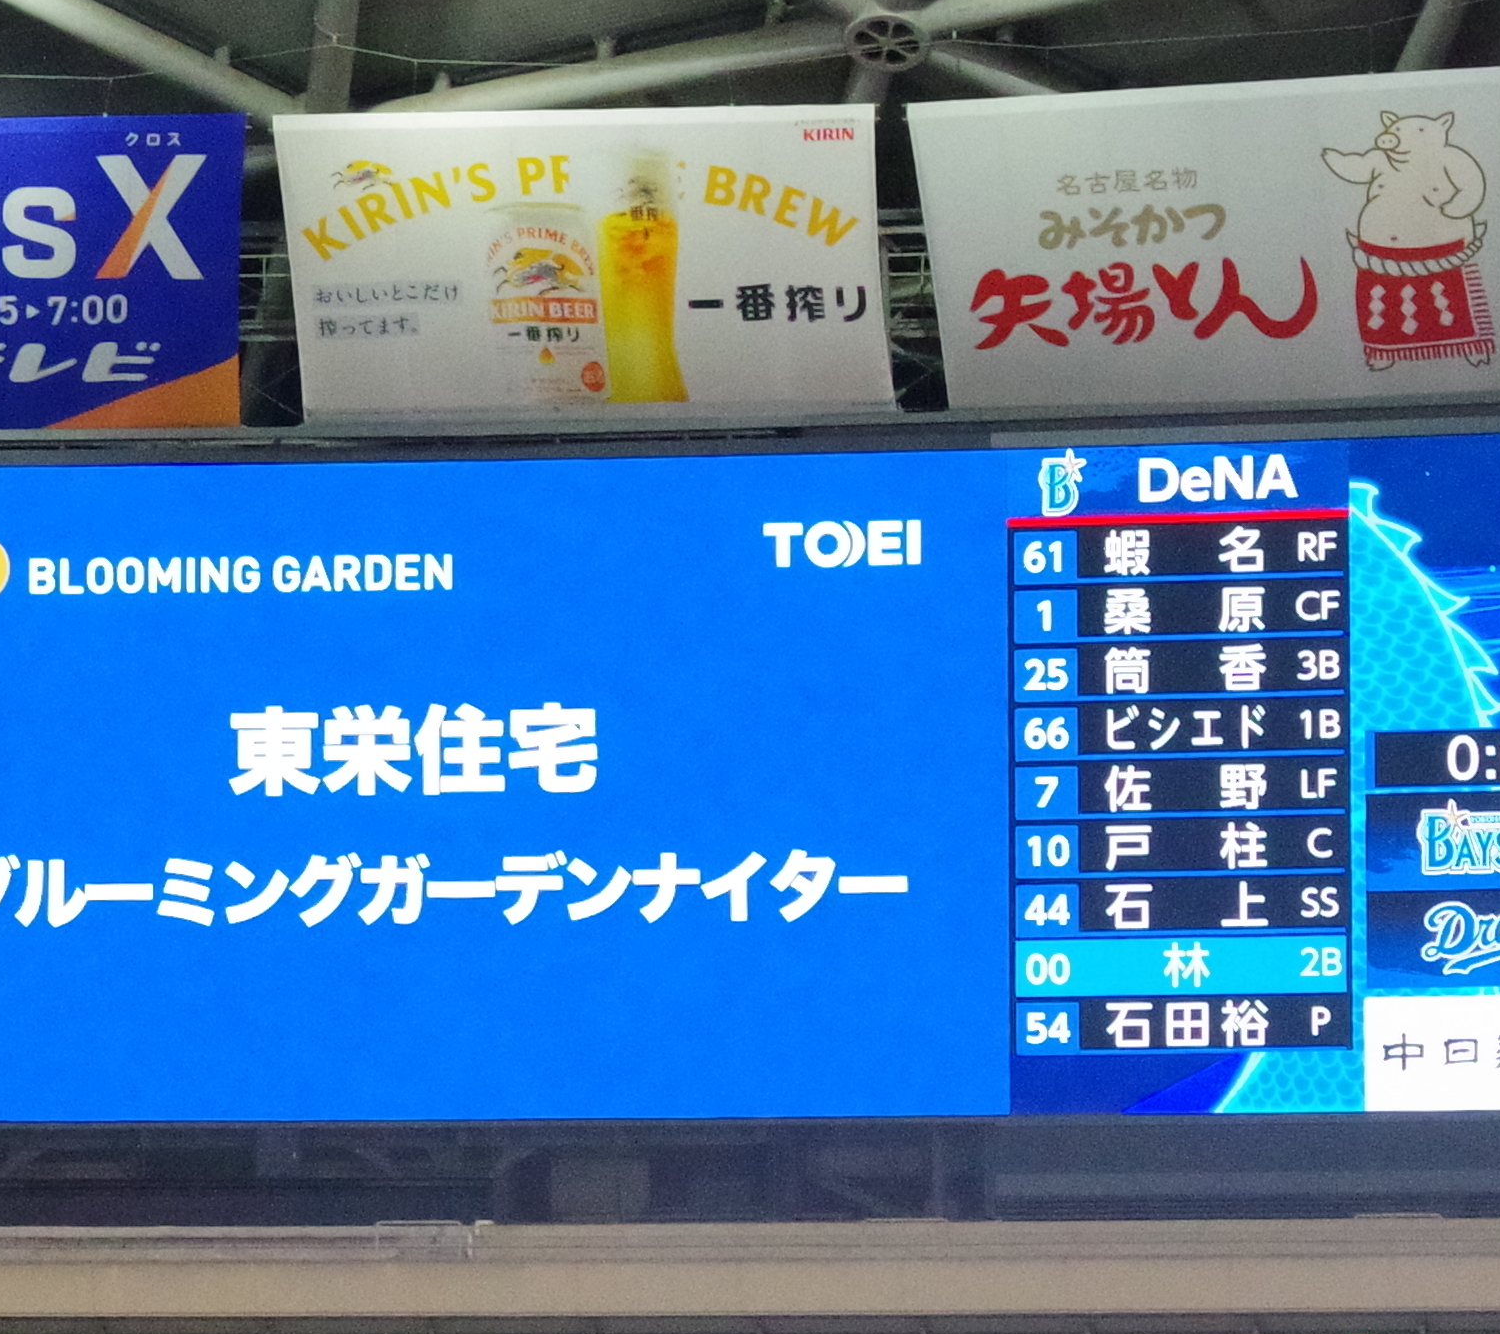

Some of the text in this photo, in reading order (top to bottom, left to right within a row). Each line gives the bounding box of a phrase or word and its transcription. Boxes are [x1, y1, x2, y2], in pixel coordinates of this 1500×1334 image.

[123, 130, 184, 148] クロス
[802, 127, 855, 142] KIRIN
[1056, 167, 1199, 197] 名古屋名物
[300, 161, 498, 262] KIRIN'S
[702, 164, 860, 248] BREW
[1037, 202, 1226, 251] みそかつ
[46, 293, 130, 326] 7:00
[314, 283, 460, 305] おいしいとこだけ
[494, 300, 596, 318] KIRIN BEER
[687, 284, 868, 323] 一番搾り
[969, 256, 1318, 350] 矢場とん
[1137, 453, 1300, 504] DeNA
[28, 552, 454, 596] BLOOMING GARDEN
[1022, 540, 1063, 575] 61
[1296, 529, 1339, 563] RF
[1036, 585, 1342, 636] 1 桑原 CF
[1023, 643, 1341, 695] 25 筒香 3B
[227, 701, 599, 798] 東栄住宅
[1023, 703, 1342, 751] 66 ビシエド 1B
[1034, 762, 1338, 814] 7 佐野 LF
[1026, 820, 1334, 872] 10 戸柱 C
[1023, 880, 1341, 930] 44 石上 SS
[1025, 940, 1343, 989] 00 林 2B
[1025, 998, 1332, 1049] 54 石田裕 P
